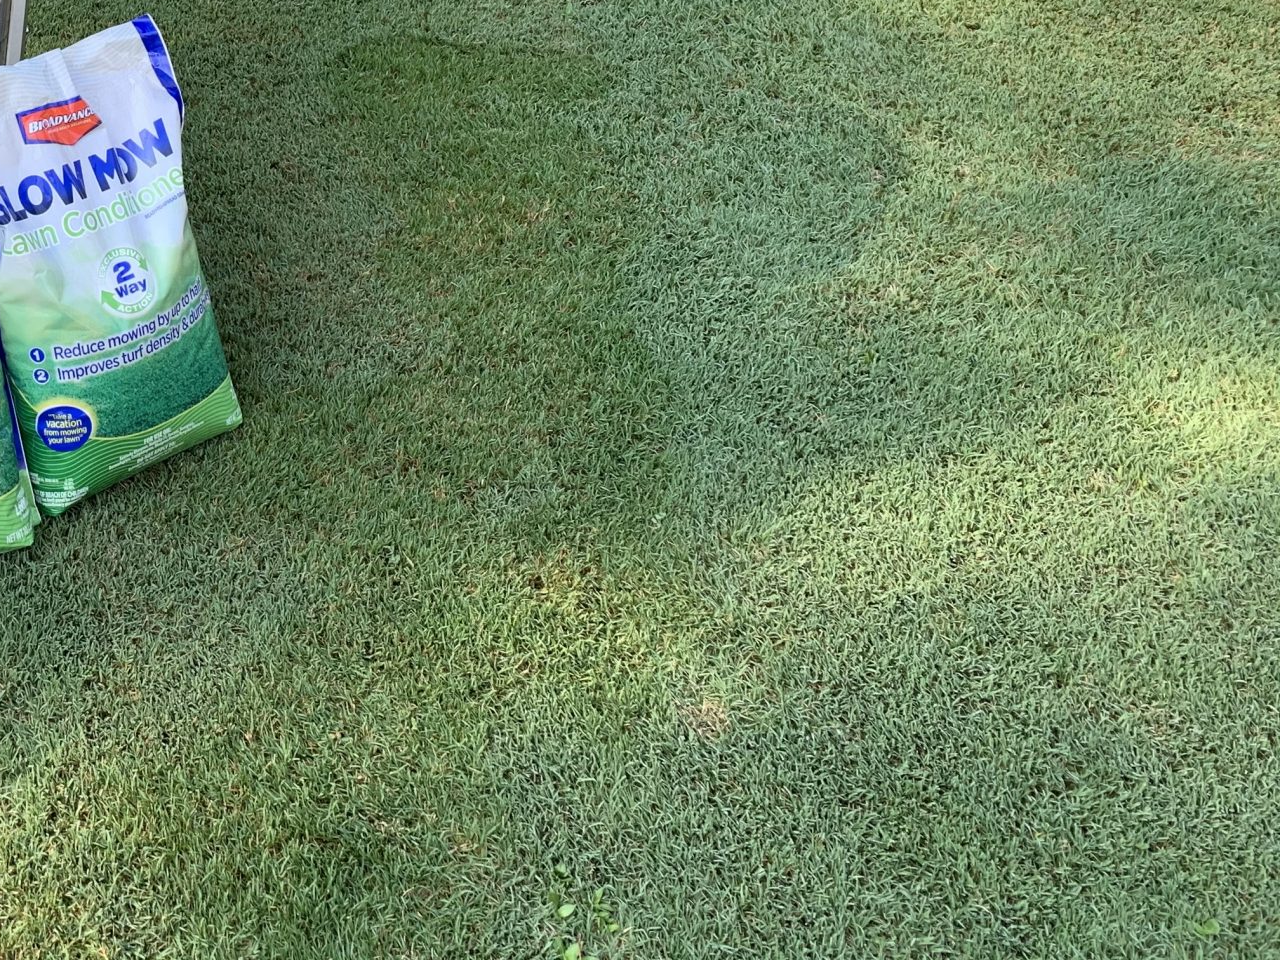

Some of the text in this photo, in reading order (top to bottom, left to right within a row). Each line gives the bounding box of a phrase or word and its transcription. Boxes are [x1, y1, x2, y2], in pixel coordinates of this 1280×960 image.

[88, 117, 173, 193] MOW
[113, 261, 135, 284] 2
[115, 278, 146, 298] Way
[118, 292, 153, 312] ACTION
[32, 349, 42, 362] 1
[53, 340, 105, 359] Reduce
[108, 320, 156, 348] mowing
[157, 311, 170, 327] by
[171, 302, 181, 318] up
[181, 294, 190, 308] to
[36, 370, 47, 381] 2
[57, 357, 120, 380] Improves
[121, 344, 144, 364] turf
[146, 325, 181, 354] density
[181, 317, 189, 331] &
[43, 426, 88, 436] from mowing
[45, 419, 82, 428] vacation
[47, 436, 63, 445] your
